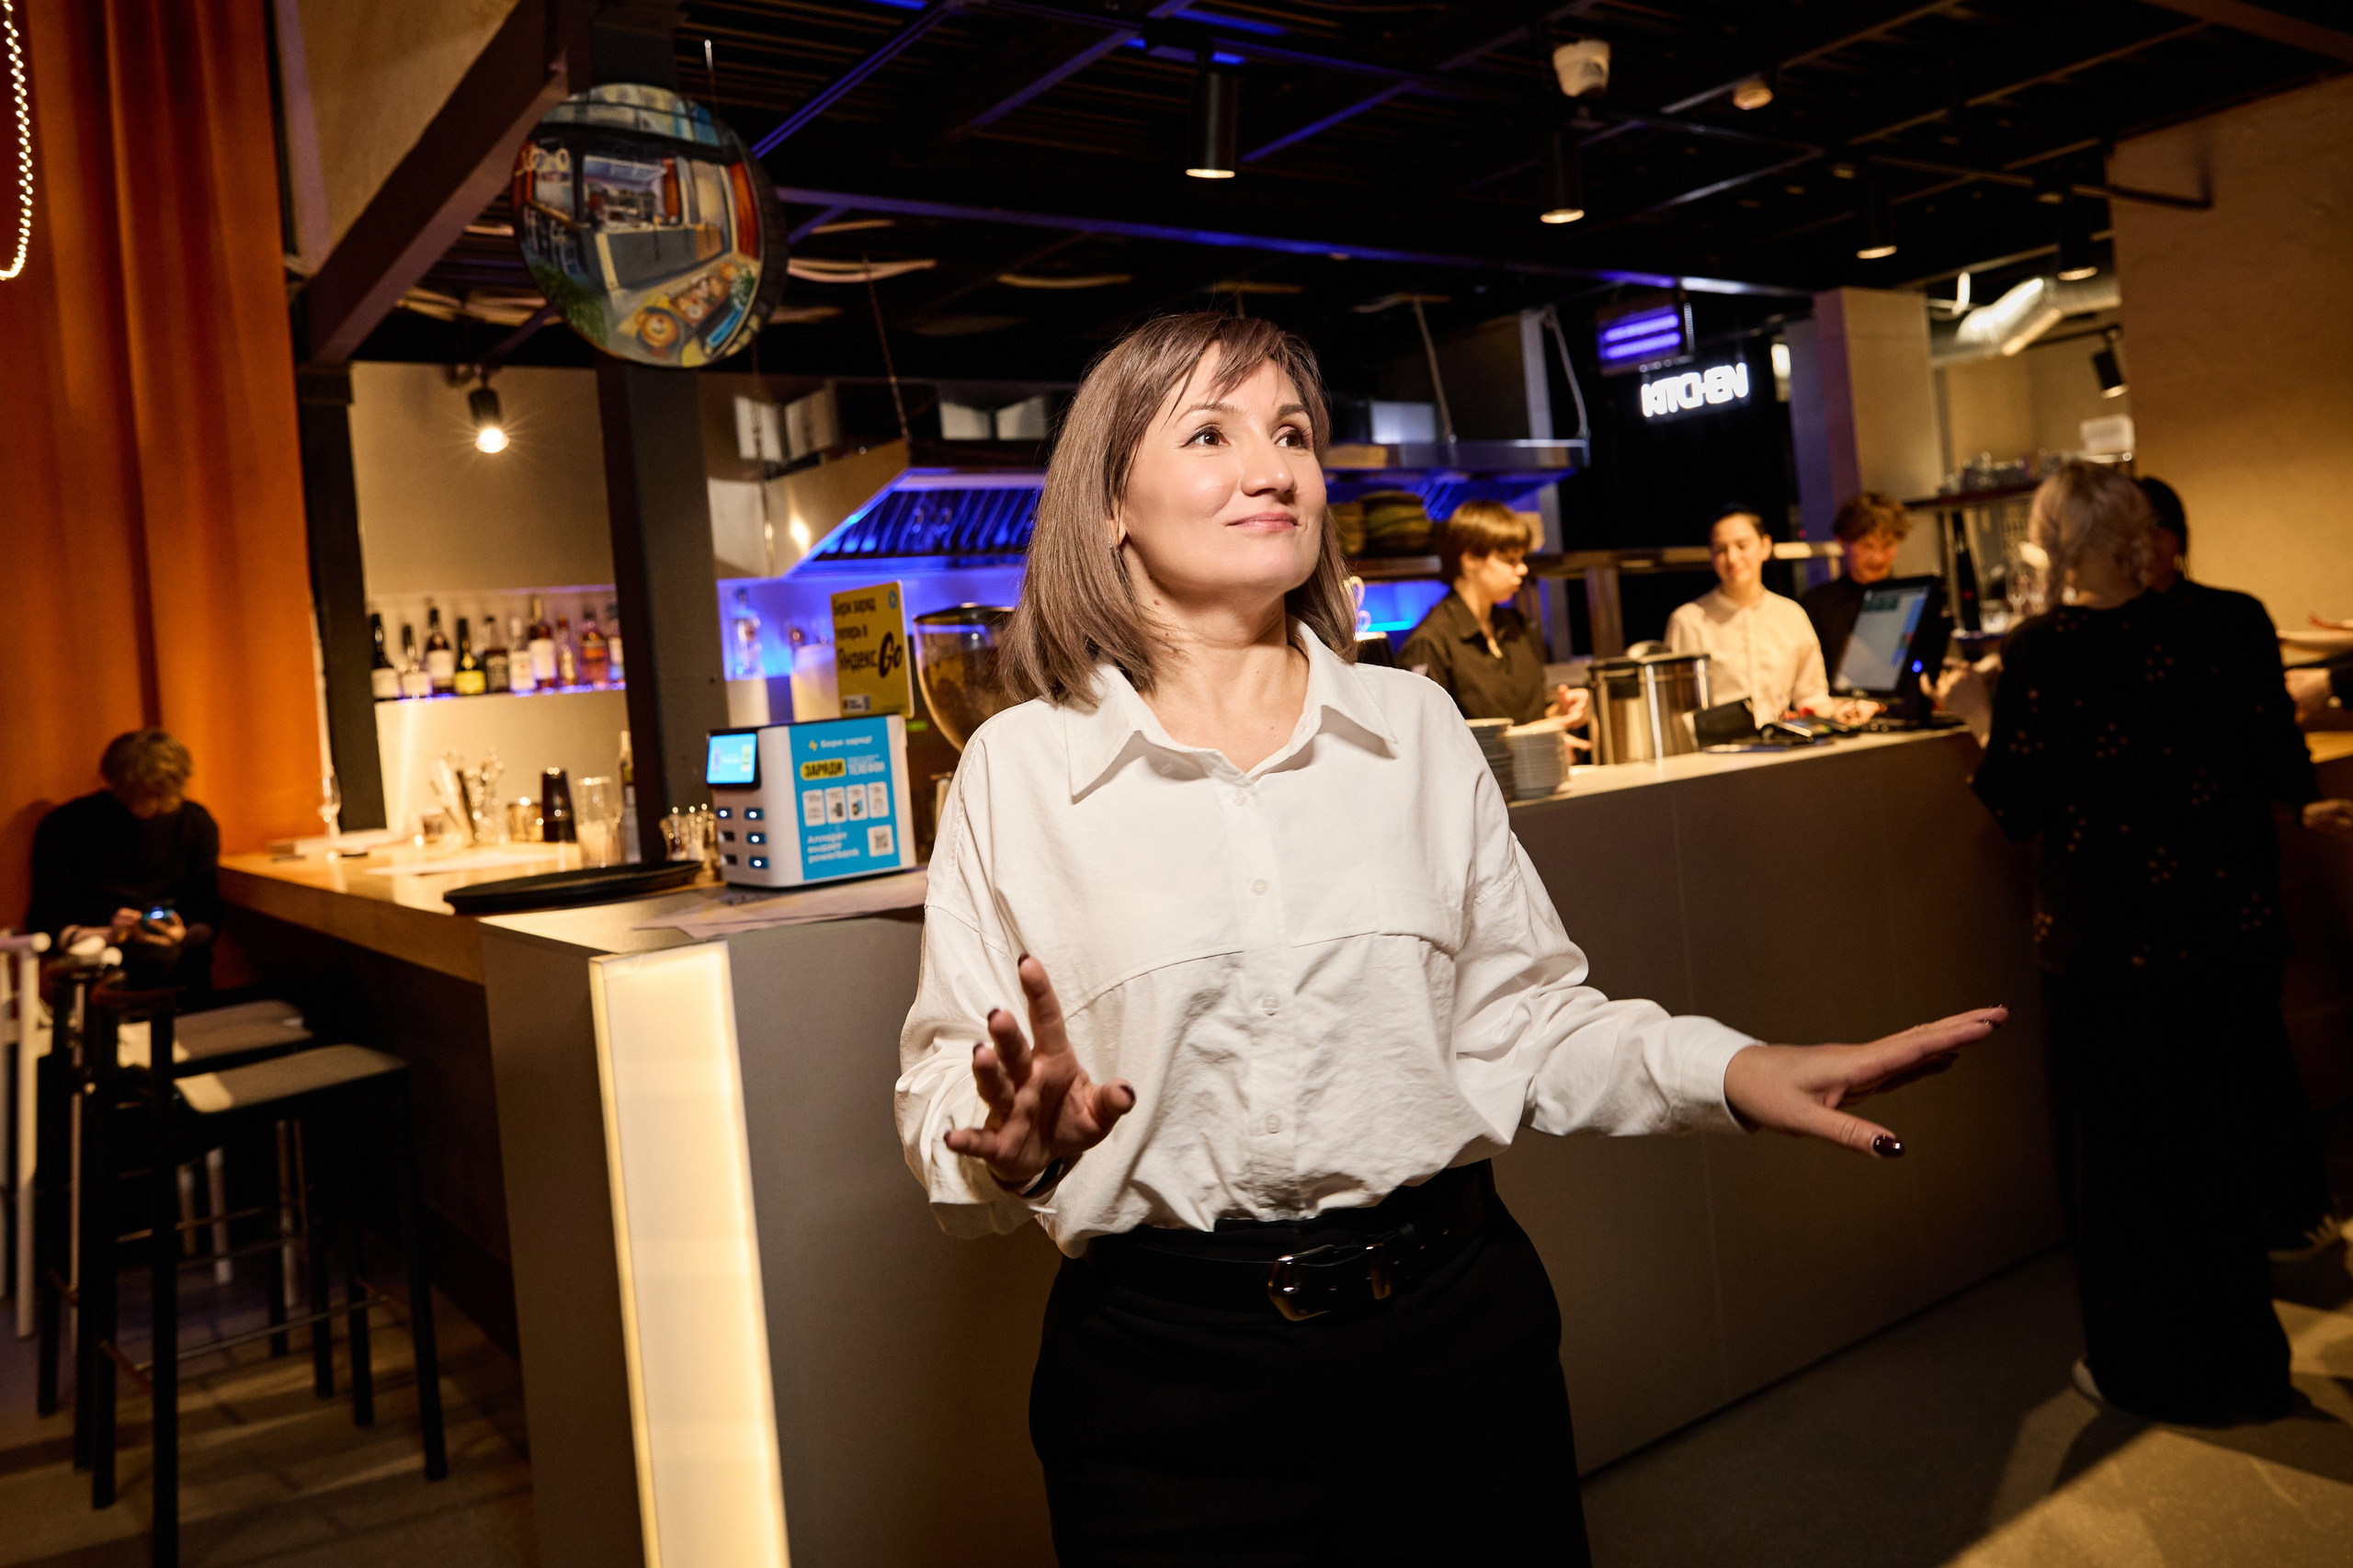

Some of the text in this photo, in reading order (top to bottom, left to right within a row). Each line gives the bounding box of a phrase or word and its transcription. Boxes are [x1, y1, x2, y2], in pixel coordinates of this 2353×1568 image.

[1642, 362, 1749, 418] KITCHEN
[838, 631, 903, 678] Яндекс Go
[803, 761, 843, 778] ЗАРЯДИ
